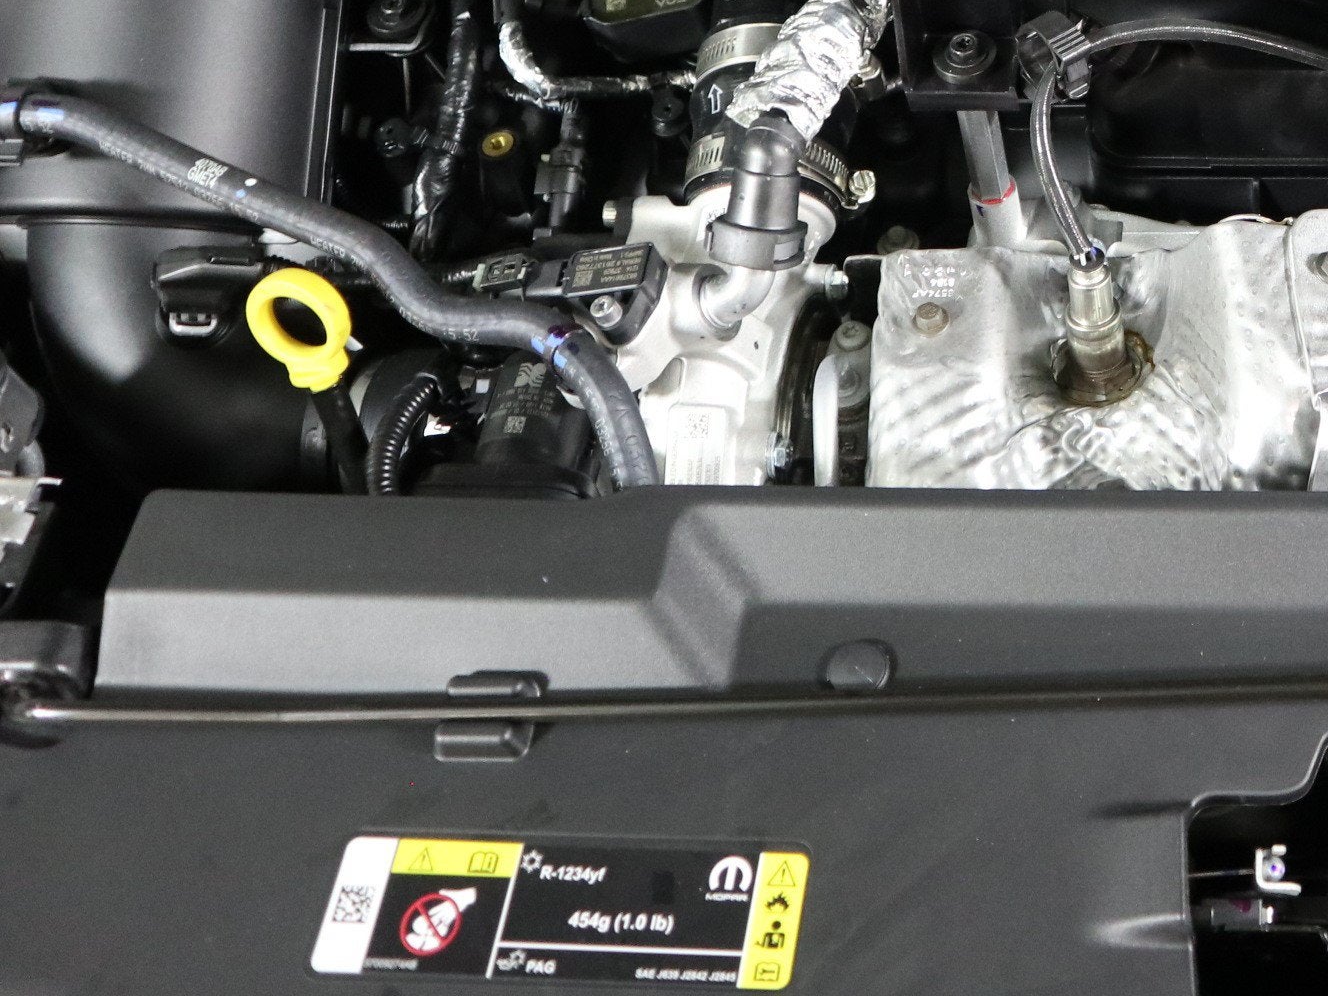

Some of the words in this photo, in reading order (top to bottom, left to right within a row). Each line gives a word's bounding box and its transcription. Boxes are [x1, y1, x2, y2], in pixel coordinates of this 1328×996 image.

[539, 864, 608, 886] R-1234yf
[705, 892, 749, 902] MOPAR
[567, 910, 611, 933] 454g
[613, 912, 647, 934] (1.0
[650, 913, 675, 936] lb)
[525, 958, 557, 975] PAG
[635, 967, 656, 979] SAE
